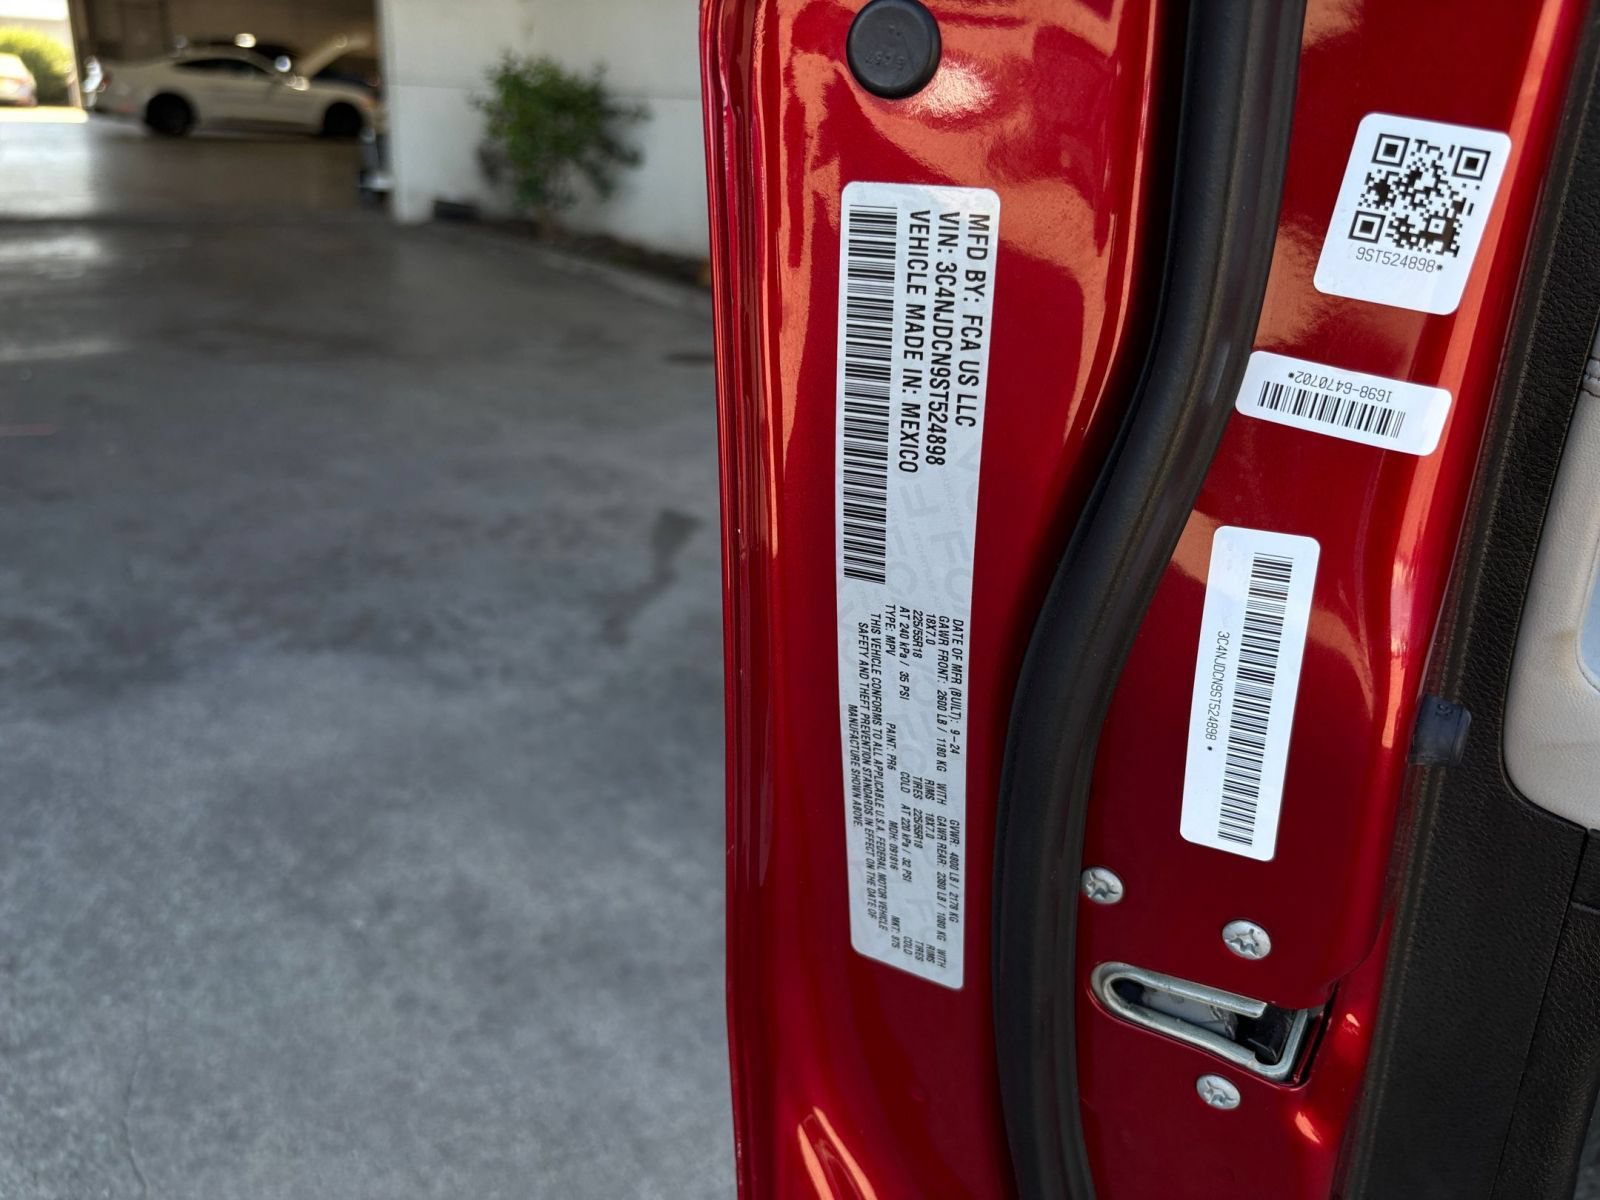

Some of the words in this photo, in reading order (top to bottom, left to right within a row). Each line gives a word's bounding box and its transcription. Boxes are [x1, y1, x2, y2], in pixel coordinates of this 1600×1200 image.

[937, 212, 960, 254] VIN:
[967, 214, 990, 260] MFD
[906, 210, 930, 295] VEHICLE
[963, 270, 985, 303] BY:
[903, 303, 925, 360] MADE
[960, 314, 983, 351] FCA
[926, 261, 957, 466] 3C4NJDCN9ST524898
[958, 360, 979, 386] US
[902, 369, 922, 394] IN:
[955, 393, 977, 428] LLC
[899, 402, 920, 473] MEXICO
[871, 614, 881, 634] THIS
[886, 604, 895, 631] TYPE:
[900, 606, 910, 620] AT
[858, 622, 869, 658] SAFETY
[900, 623, 909, 639] 240
[913, 610, 923, 659] 225/55R18
[926, 614, 936, 645] 18X7.0
[938, 616, 949, 646] GAWR
[952, 619, 963, 645] DATE
[871, 638, 881, 675] VEHICLE
[886, 635, 895, 656] MPV
[900, 642, 909, 658] kPa
[952, 648, 962, 661] OF
[859, 660, 869, 679] AND
[900, 672, 909, 682] 35
[937, 649, 948, 684] FRONT:
[952, 664, 962, 684] MFR
[860, 683, 869, 710] THEFT
[900, 685, 909, 700] PSI
[1206, 631, 1230, 740] 3C4NJDCN9ST524898
[872, 678, 882, 726] CONFORMS
[937, 690, 947, 711] 2600
[948, 688, 962, 723] (BUILT):
[937, 714, 947, 725] LB
[848, 704, 858, 766] MANUFACTURE
[861, 713, 871, 765] PREVENTION
[873, 729, 882, 739] TO
[887, 723, 896, 751] PAINT:
[873, 741, 883, 756] ALL
[937, 739, 946, 757] 1180
[887, 754, 896, 771] PR6
[937, 760, 947, 772] KG
[852, 769, 861, 798] SHOWN
[862, 767, 873, 816] STANDARDS
[873, 759, 885, 808] APPLICABLE
[900, 772, 910, 793] COLD
[913, 776, 923, 800] TIRES
[925, 779, 935, 800] RIMS
[937, 783, 947, 805] WITH
[875, 810, 885, 832] U.S.A.
[901, 804, 910, 816] AT
[865, 817, 873, 827] IN
[889, 820, 898, 841] MDH:
[925, 813, 935, 839] 18X7.0
[937, 816, 947, 840] GAWR
[865, 828, 874, 857] EFFECT
[902, 833, 911, 847] kPa
[950, 820, 959, 847] GVWR:
[876, 836, 886, 869] FEDERAL
[902, 857, 911, 867] 32
[937, 843, 946, 867] REAR:
[866, 858, 875, 870] ON
[867, 871, 876, 886] THE
[876, 873, 887, 899] MOTOR
[902, 869, 912, 882] PSI
[950, 872, 959, 883] LB
[867, 888, 876, 908] DATE
[937, 892, 946, 902] LB
[868, 908, 877, 919] OF
[878, 901, 888, 931] VEHICLE
[949, 912, 959, 923] KG
[904, 936, 912, 955] COLD
[937, 931, 946, 941] KG
[915, 941, 924, 962] TIRES
[926, 944, 935, 963] RIMS
[937, 949, 946, 968] WITH
